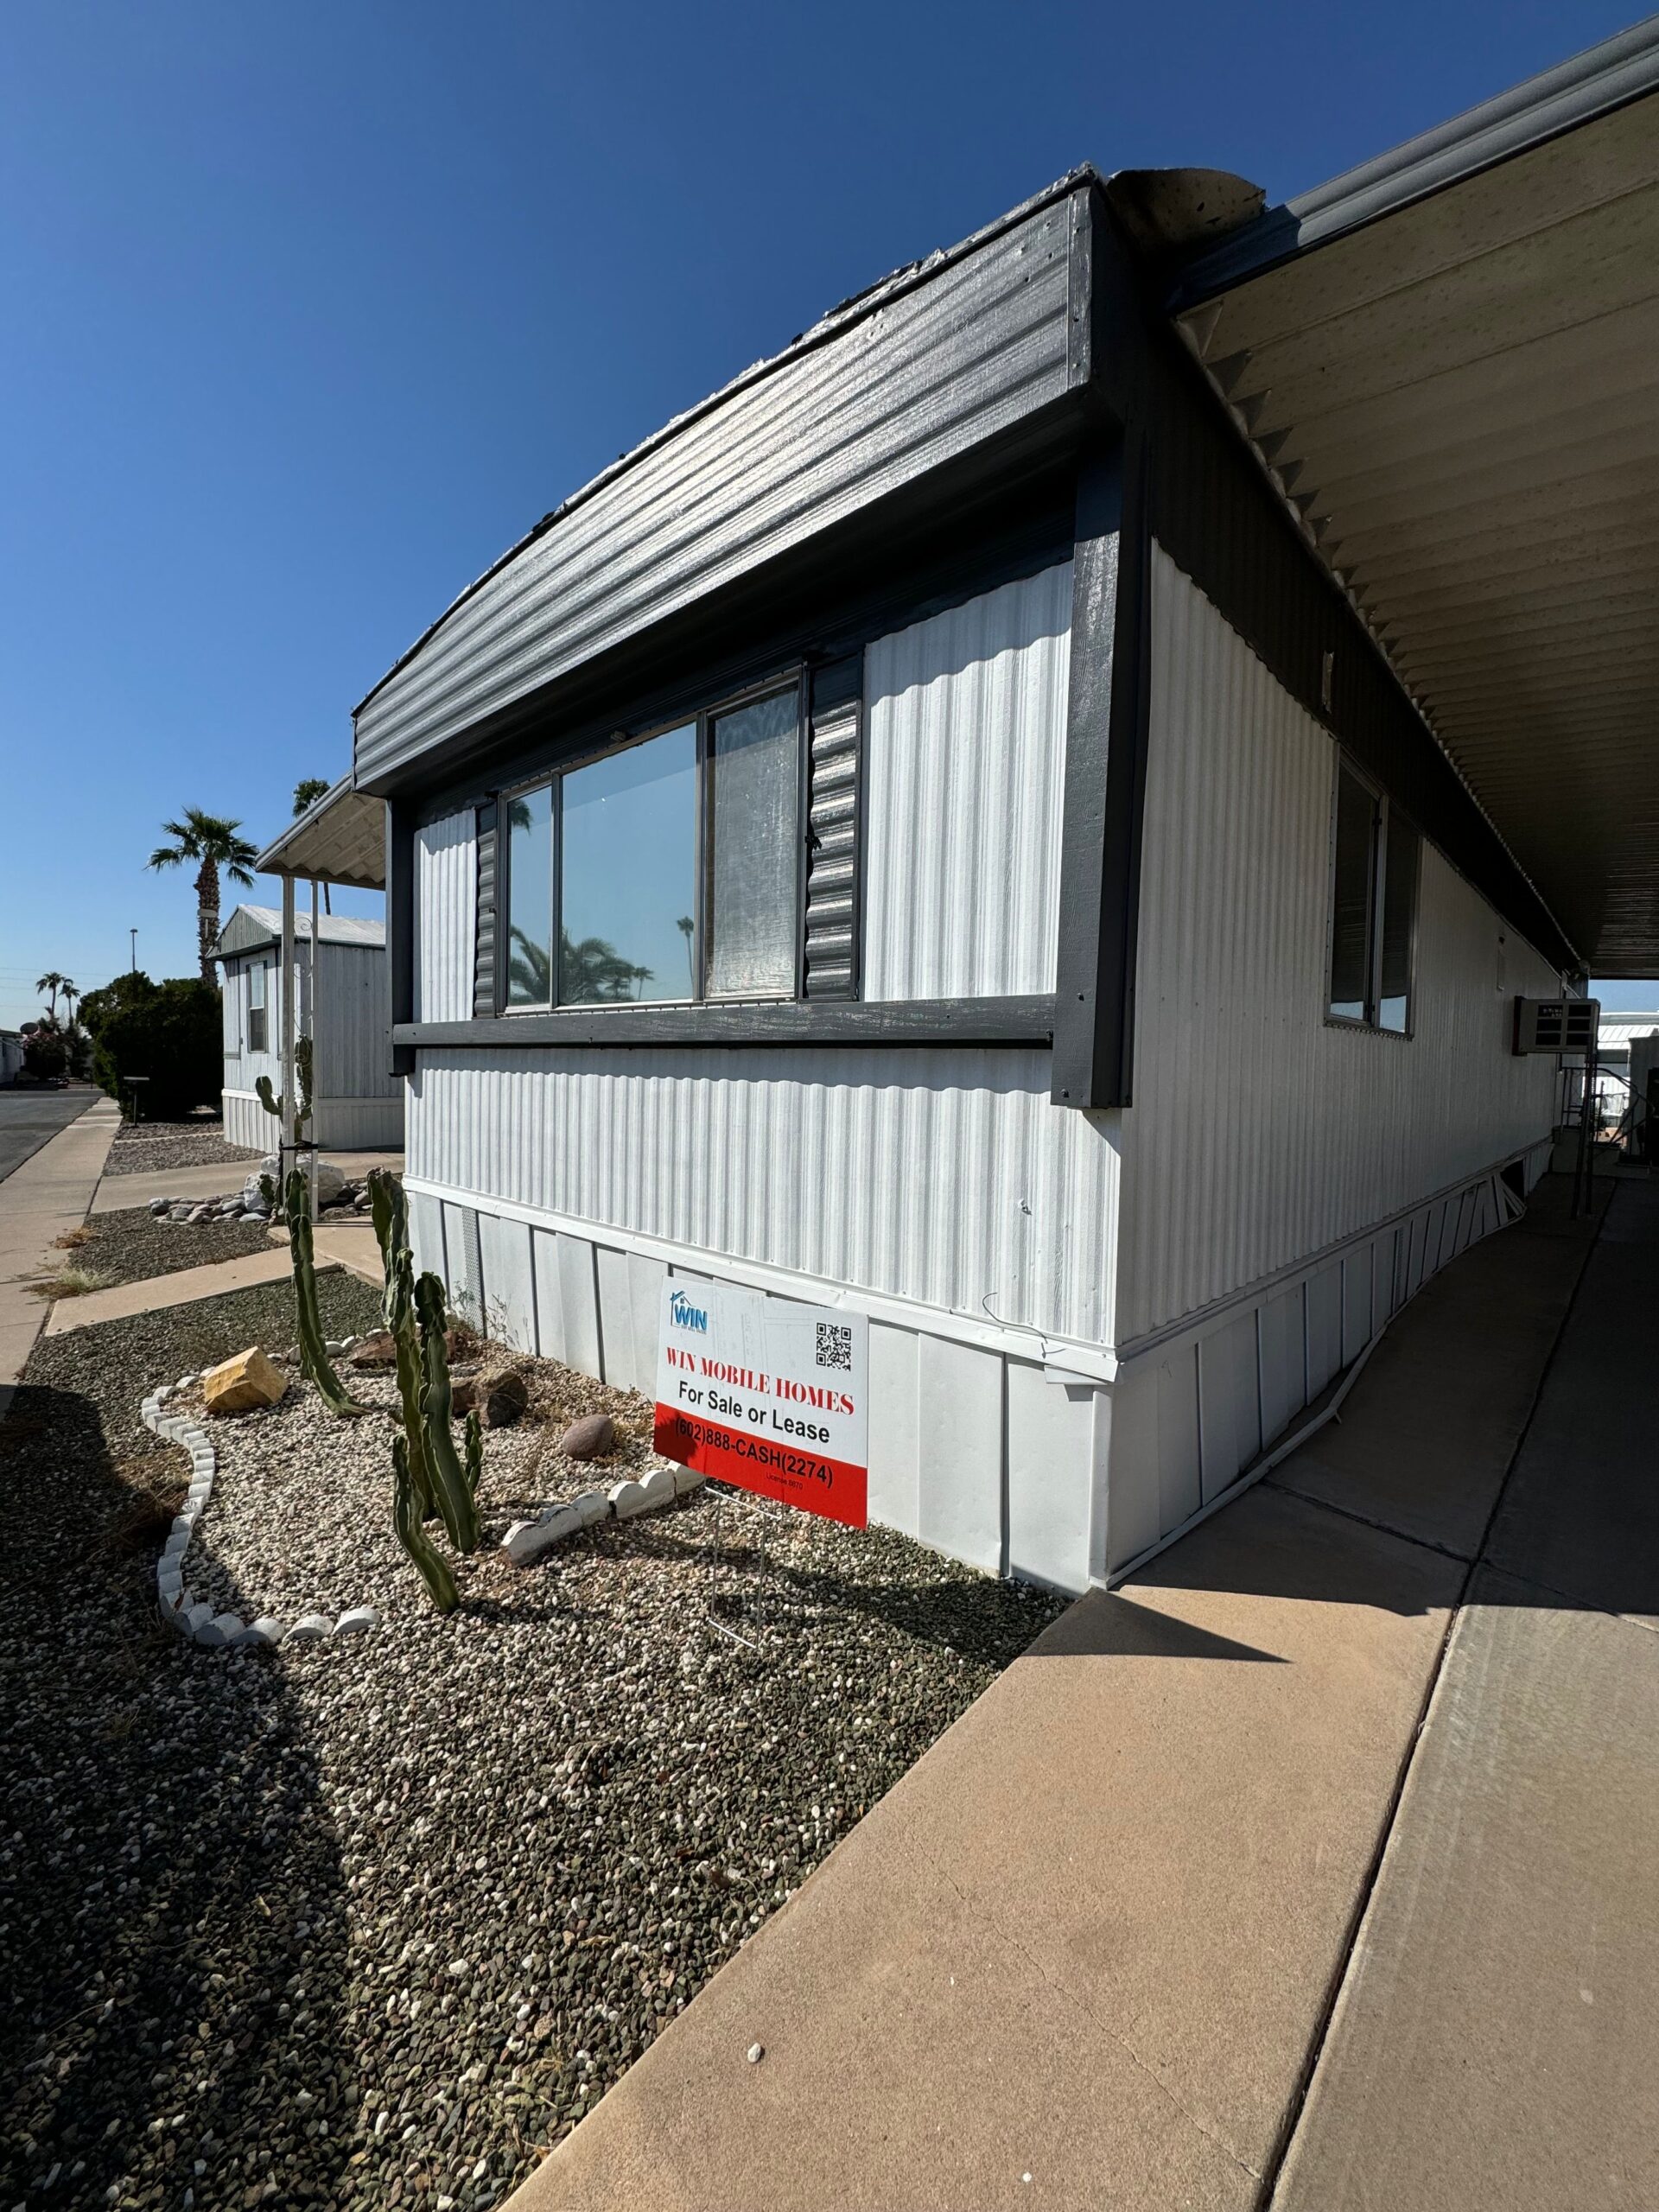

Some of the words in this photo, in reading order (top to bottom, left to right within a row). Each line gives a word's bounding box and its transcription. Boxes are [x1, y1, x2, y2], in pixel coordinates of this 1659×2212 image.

[674, 1304, 708, 1331] WIN
[666, 1346, 696, 1372] WIN
[700, 1357, 770, 1394] MOBILE
[776, 1378, 855, 1415] HOMES
[679, 1381, 703, 1404] For
[708, 1390, 742, 1417] Sale
[748, 1407, 766, 1425] or
[772, 1409, 830, 1443] Lease
[676, 1418, 833, 1489] (602)888-CASH(2274)
